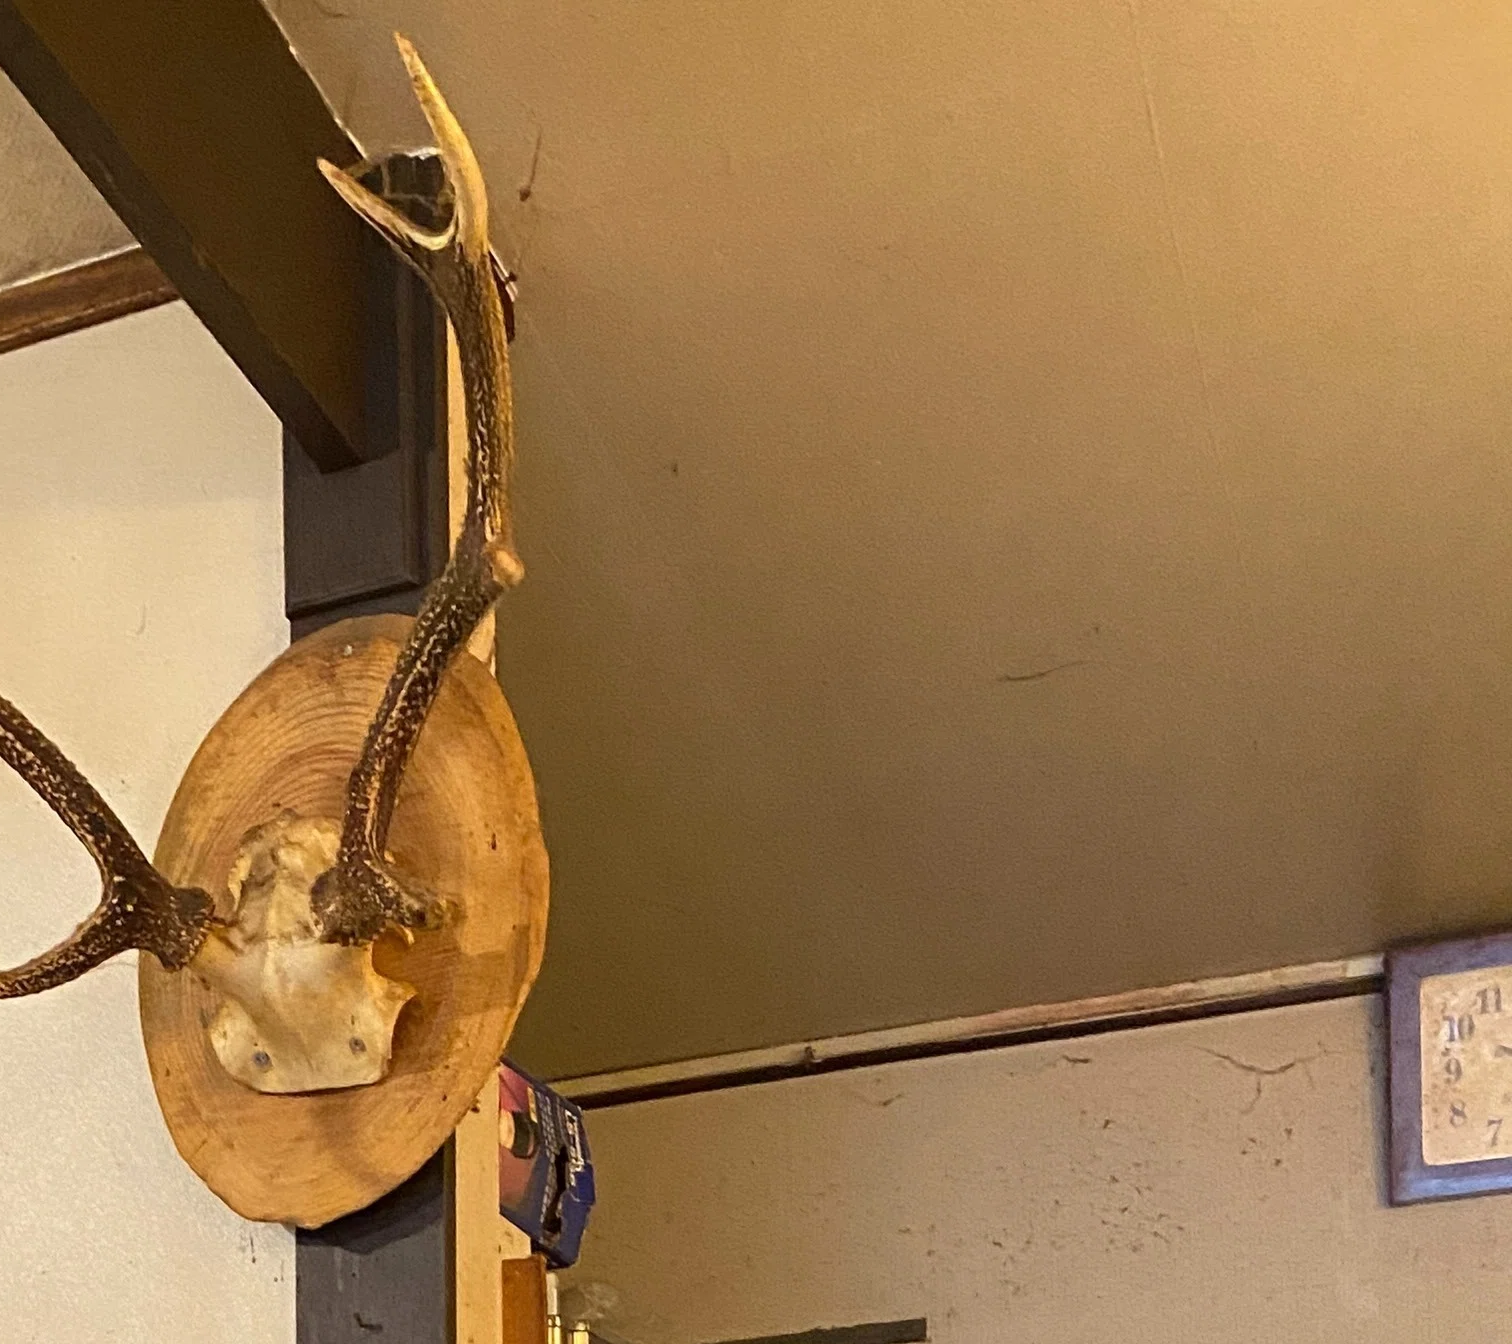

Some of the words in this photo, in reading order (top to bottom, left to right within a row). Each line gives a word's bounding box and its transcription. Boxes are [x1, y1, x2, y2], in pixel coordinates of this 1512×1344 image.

[1475, 985, 1503, 1015] 11
[1443, 1013, 1475, 1042] 10
[1445, 1058, 1463, 1083] 9
[1449, 1100, 1467, 1128] 8
[1487, 1119, 1503, 1147] 7
